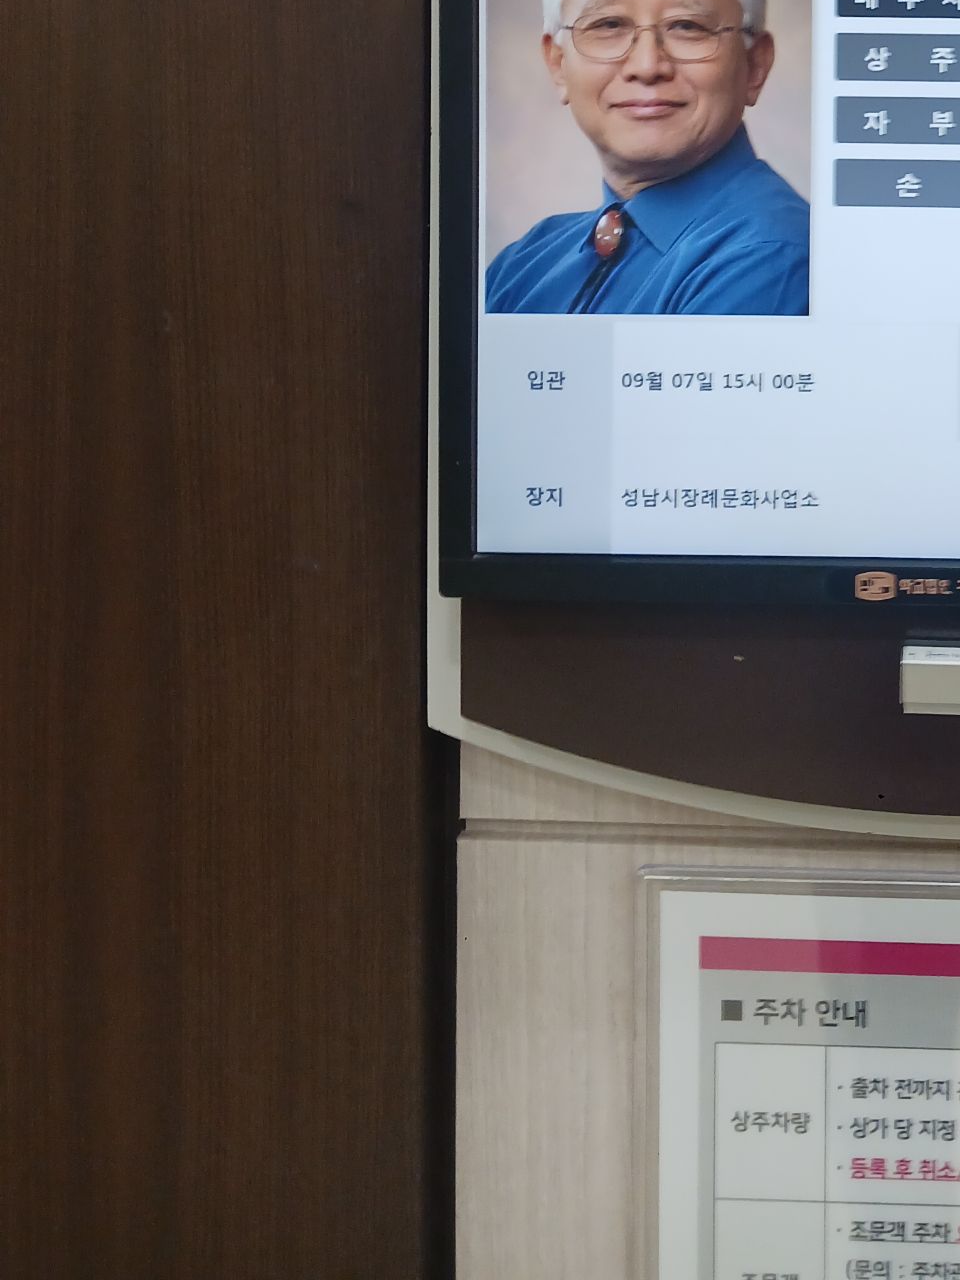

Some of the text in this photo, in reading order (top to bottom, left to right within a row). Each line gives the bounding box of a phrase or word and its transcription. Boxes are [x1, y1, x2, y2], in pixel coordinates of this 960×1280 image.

[895, 173, 923, 198] 손
[527, 370, 566, 391] 입관
[621, 371, 816, 393] 09월 07일 15시 00분
[525, 487, 563, 508] 장지
[621, 487, 820, 510] 성남시장례문화사업소
[752, 998, 869, 1029] 주차 안내
[849, 1076, 889, 1100] 출차
[894, 1078, 952, 1102] 전까지
[730, 1110, 812, 1134] 상주차량
[850, 1117, 889, 1140] 상가
[893, 1118, 914, 1140] 당
[918, 1120, 956, 1142] 지정
[850, 1157, 888, 1180] 등록
[894, 1158, 913, 1179] 후
[848, 1221, 906, 1243] 조문객
[911, 1222, 952, 1243] 주차
[845, 1259, 893, 1280] (문의
